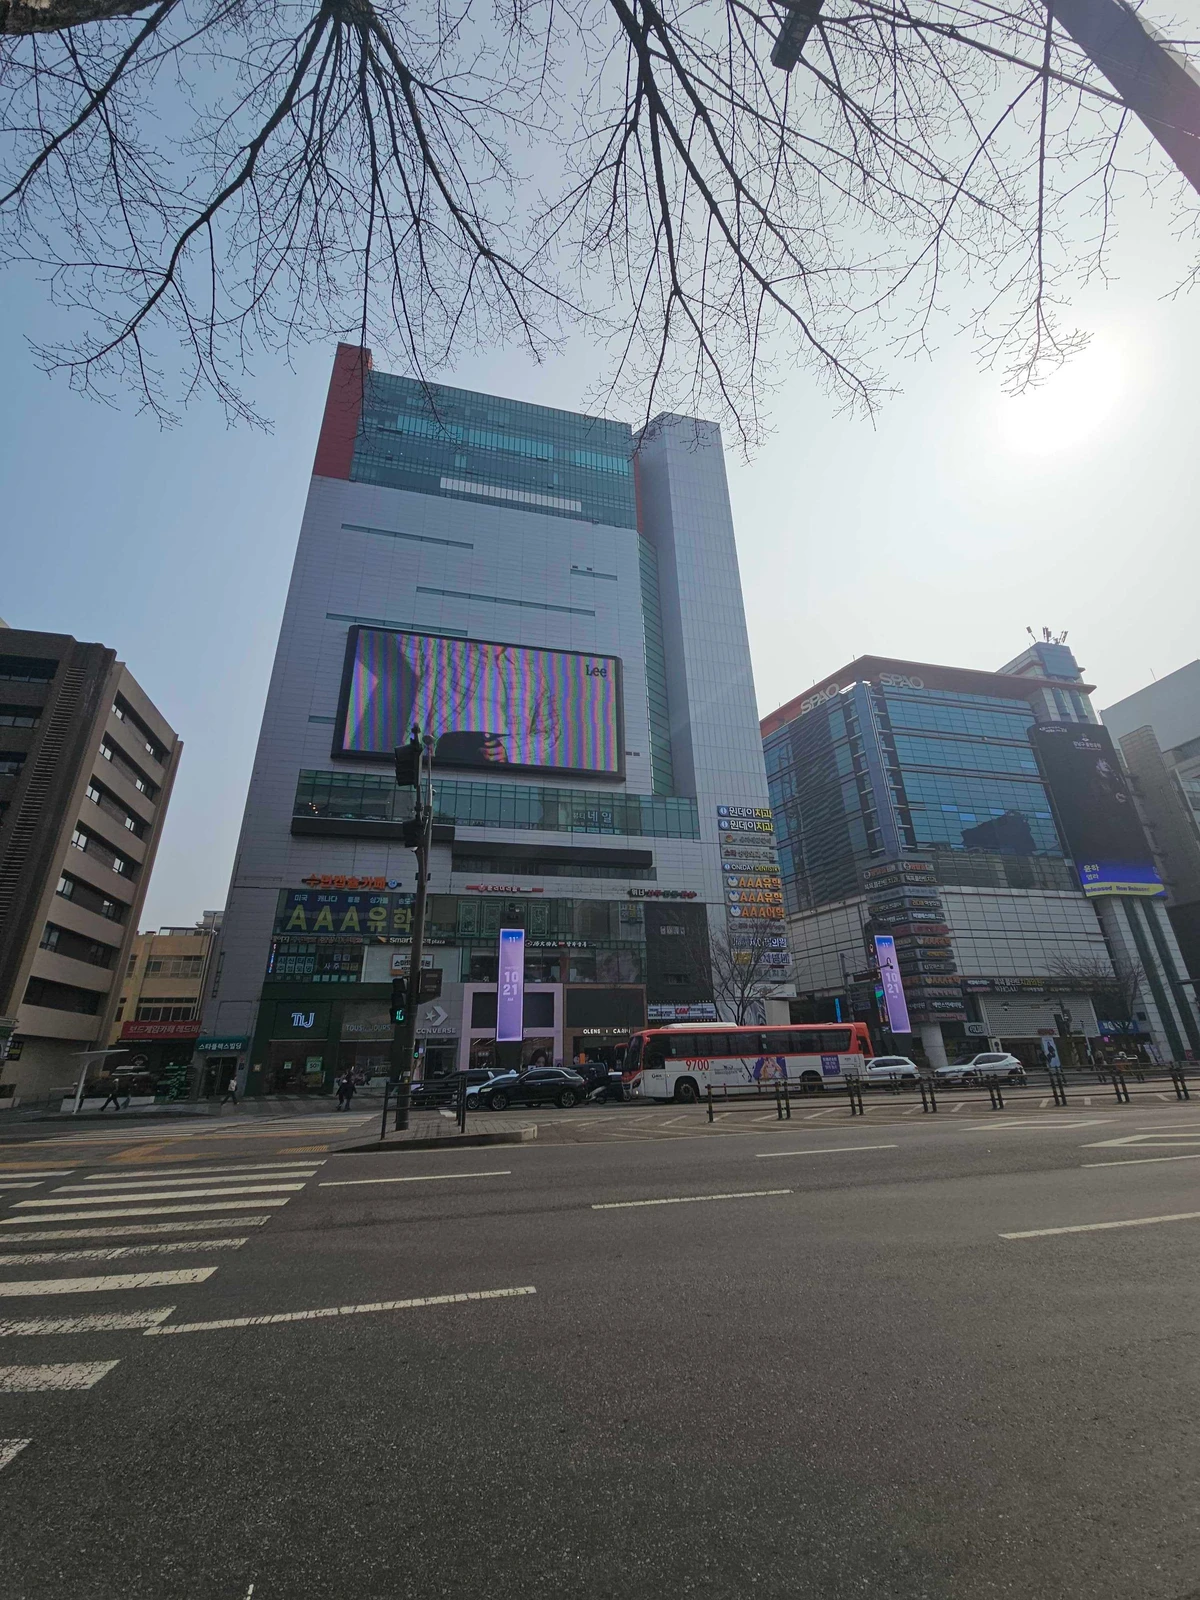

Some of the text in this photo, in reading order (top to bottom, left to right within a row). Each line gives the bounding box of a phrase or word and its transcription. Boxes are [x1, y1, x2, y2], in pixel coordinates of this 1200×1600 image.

[585, 664, 607, 678] Lee
[879, 672, 924, 690] SPAO
[800, 682, 840, 714] SPAO
[729, 807, 772, 819] 원데이치과
[730, 820, 774, 832] 원데이치과
[738, 877, 782, 889] AAA유학
[294, 894, 308, 902] 미국
[317, 895, 338, 903] 캐나다
[739, 891, 783, 903] AAA유학
[741, 906, 785, 919] AAA어학
[389, 936, 413, 944] smart
[504, 972, 519, 982] 10
[885, 973, 899, 983] 10
[503, 985, 518, 996] 21
[887, 984, 900, 994] 21
[346, 1023, 363, 1032] TOUS
[685, 1059, 709, 1071] 9700
